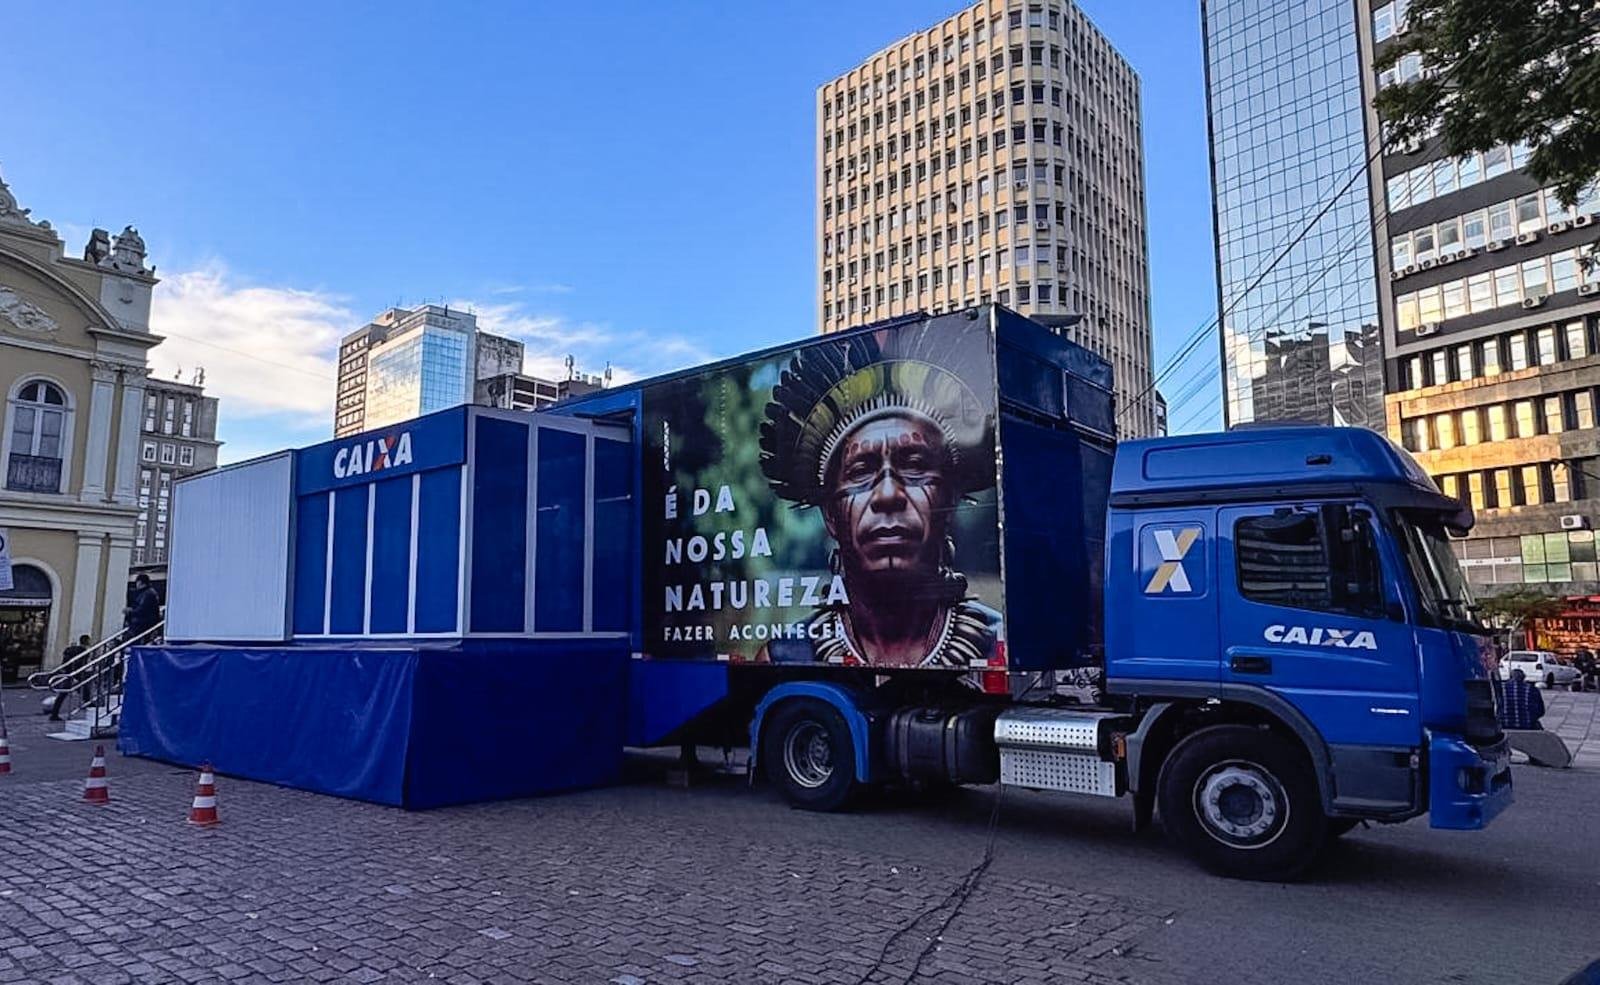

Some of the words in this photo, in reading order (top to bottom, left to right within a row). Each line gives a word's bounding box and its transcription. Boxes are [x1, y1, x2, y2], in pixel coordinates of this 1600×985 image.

[333, 431, 413, 479] CAIXA
[665, 486, 678, 519] É
[693, 485, 735, 516] DA
[665, 528, 772, 565] NOSSA
[665, 575, 850, 612] NATUREZA
[664, 626, 714, 641] FAZER
[729, 623, 844, 640] ACONTECER
[1263, 625, 1378, 650] CAIXA
